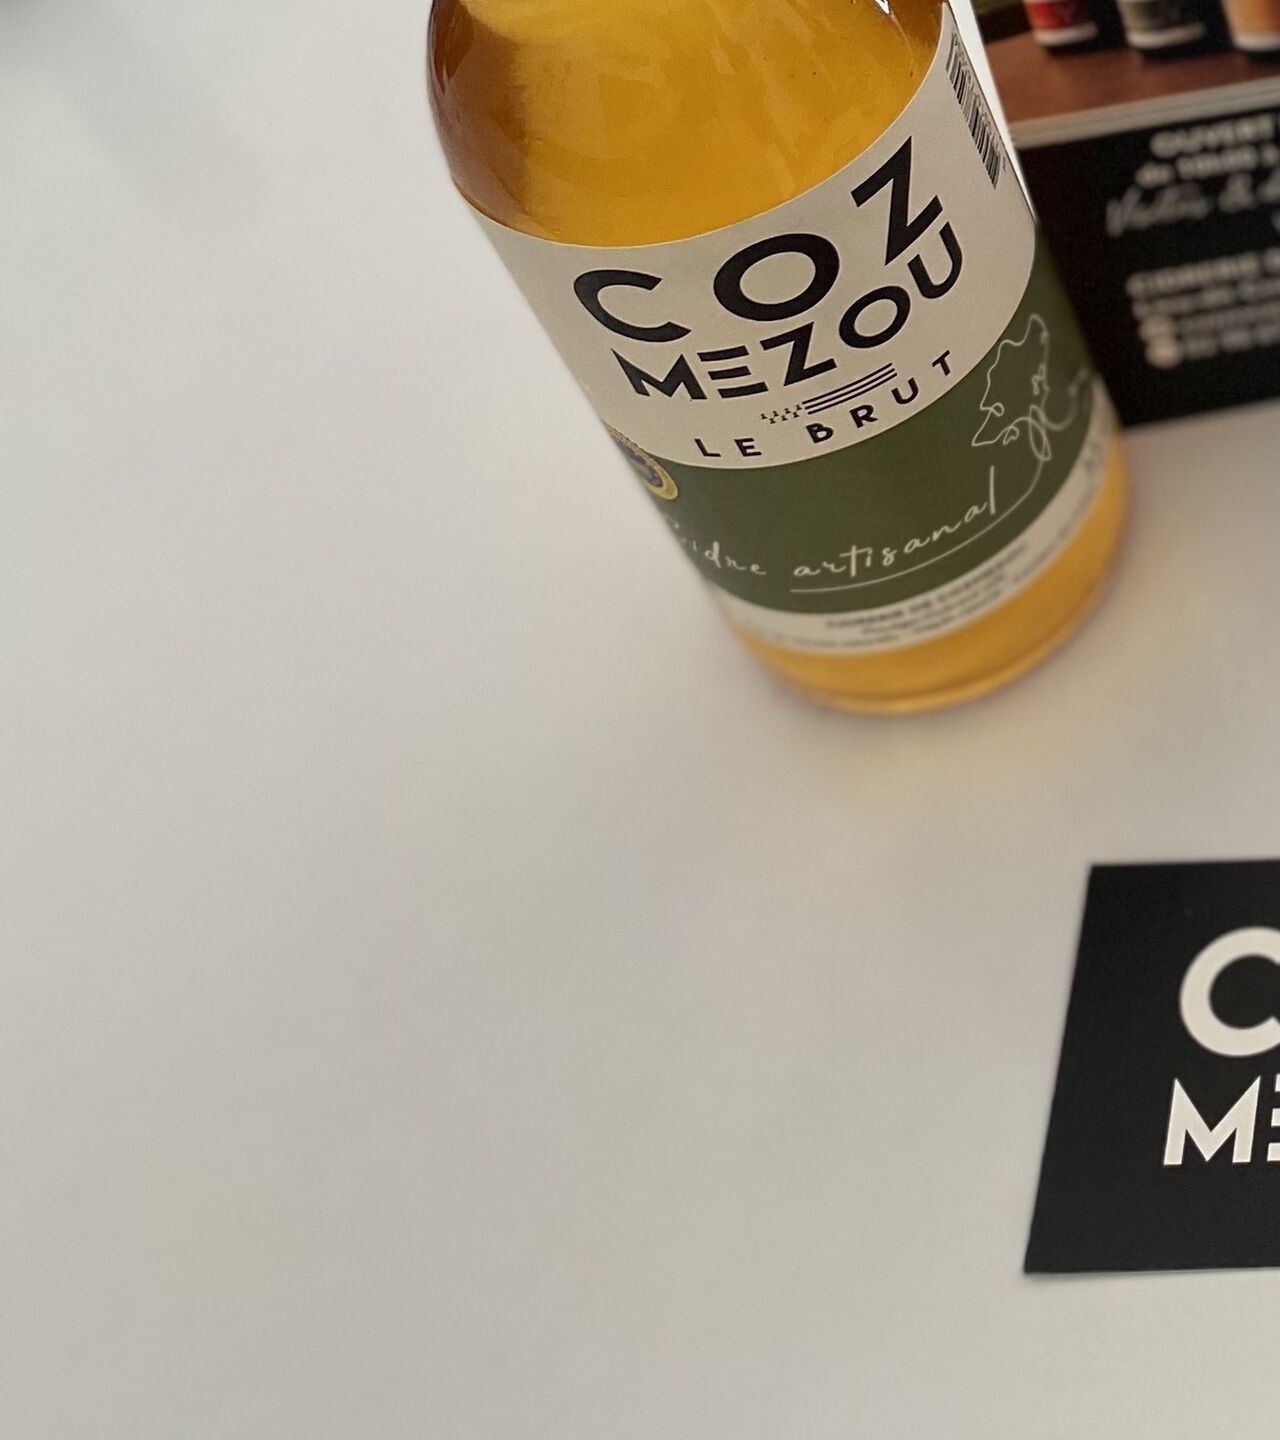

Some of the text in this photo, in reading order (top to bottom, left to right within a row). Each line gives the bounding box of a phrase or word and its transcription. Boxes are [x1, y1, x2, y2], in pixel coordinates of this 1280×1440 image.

[573, 136, 944, 343] COZ
[611, 222, 963, 400] MEZOU
[694, 350, 955, 458] LE BRUT
[792, 465, 996, 578] artisanal
